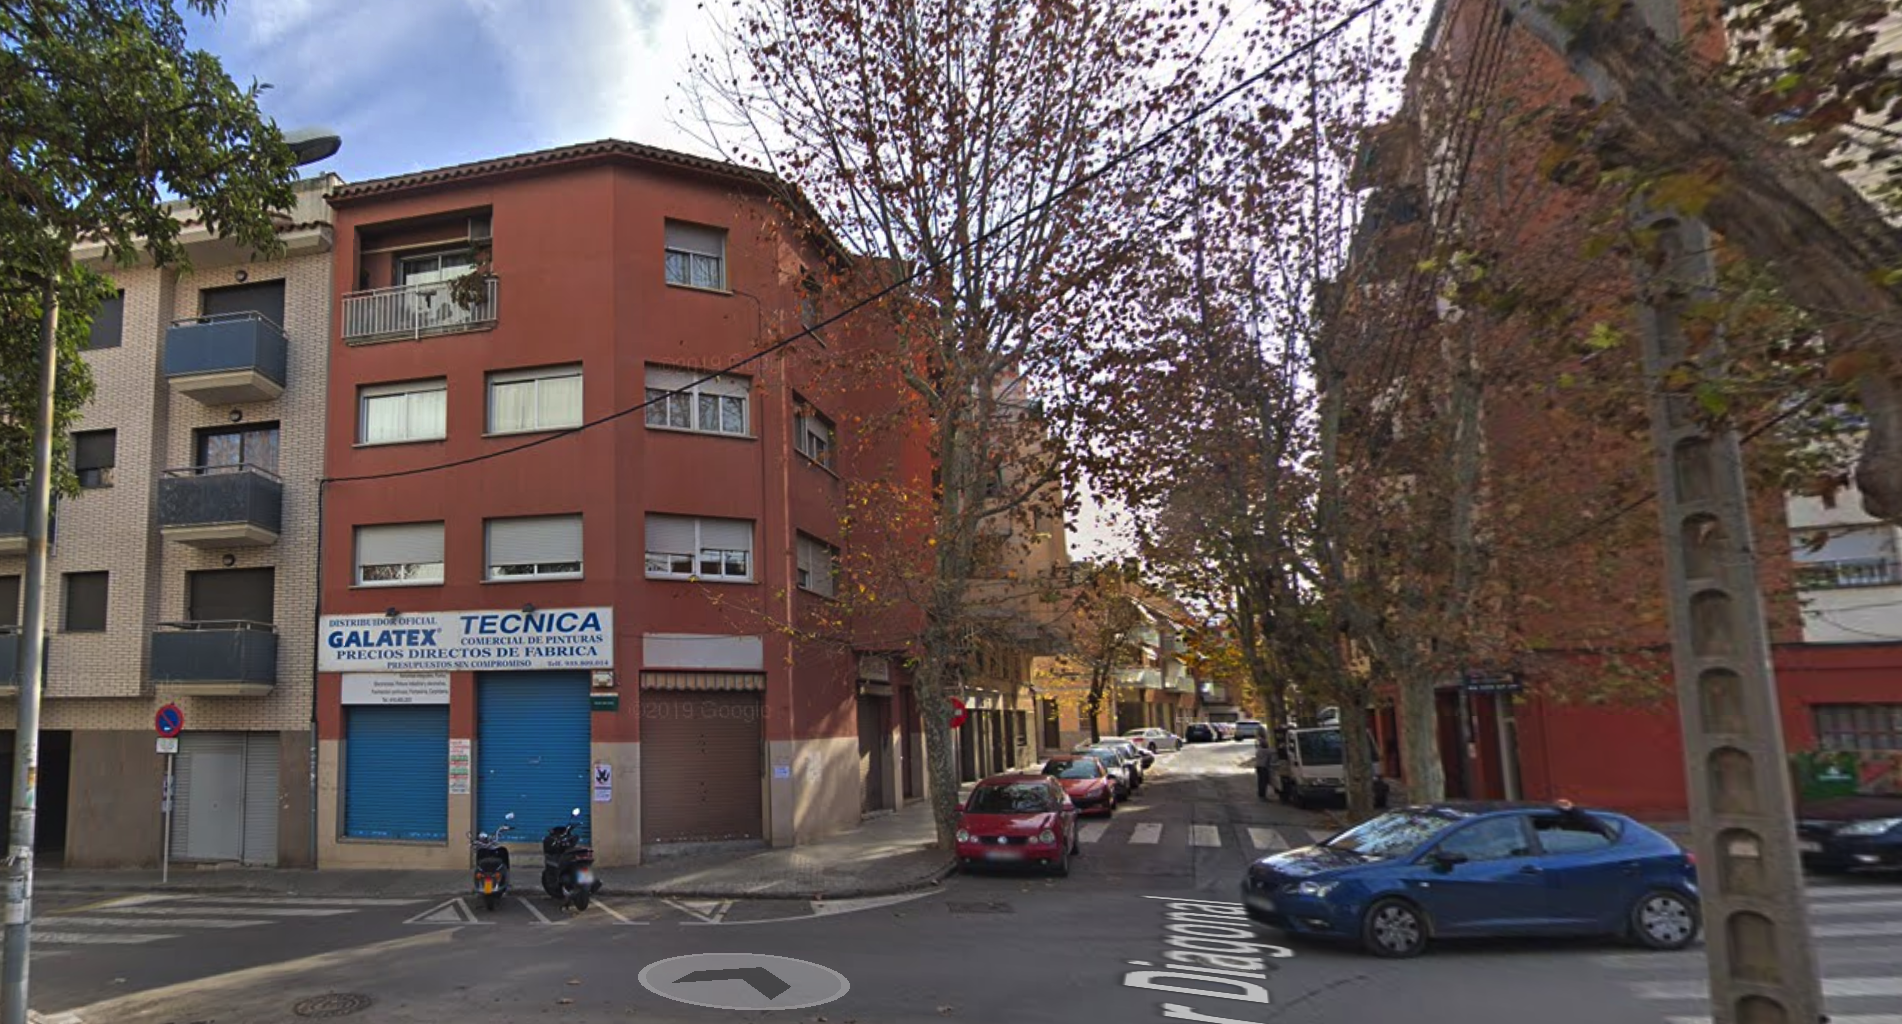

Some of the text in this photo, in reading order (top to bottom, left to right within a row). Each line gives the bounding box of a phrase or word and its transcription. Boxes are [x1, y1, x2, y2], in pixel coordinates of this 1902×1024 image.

[329, 616, 437, 627] DISTRIBUIDOR OFICIAL
[460, 611, 602, 635] TECNICA
[328, 628, 437, 649] GALATEX
[460, 634, 604, 646] COMERCIAL DE PINTURAS
[337, 645, 598, 660] PRECIOS DIRECTOS DE FABRICA
[387, 661, 452, 669] PRESUPUESTOS
[470, 660, 532, 668] COMPROMISO
